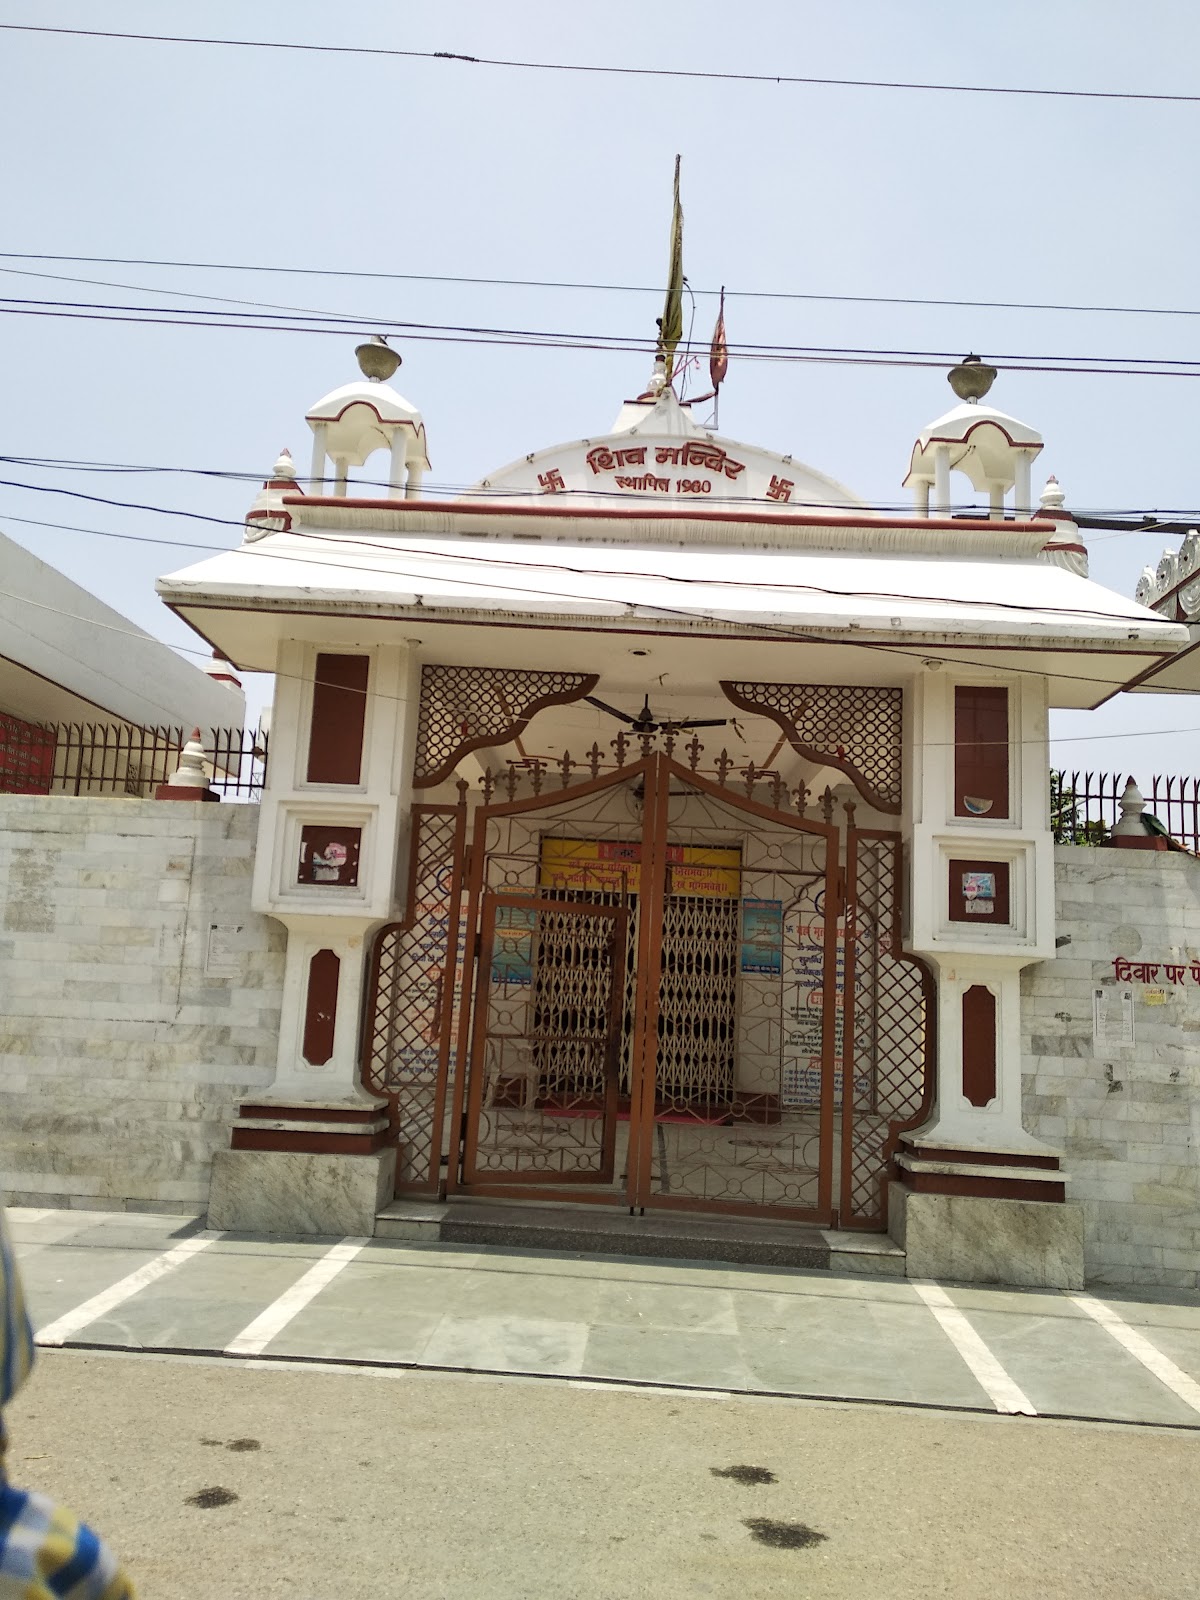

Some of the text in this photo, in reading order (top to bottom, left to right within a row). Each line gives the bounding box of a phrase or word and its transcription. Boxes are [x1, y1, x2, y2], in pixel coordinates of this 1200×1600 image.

[586, 442, 746, 480] शिव मन्दिर
[614, 473, 712, 493] स्थापित 1980
[1112, 957, 1161, 984] दिवार
[1163, 964, 1186, 985] पर
